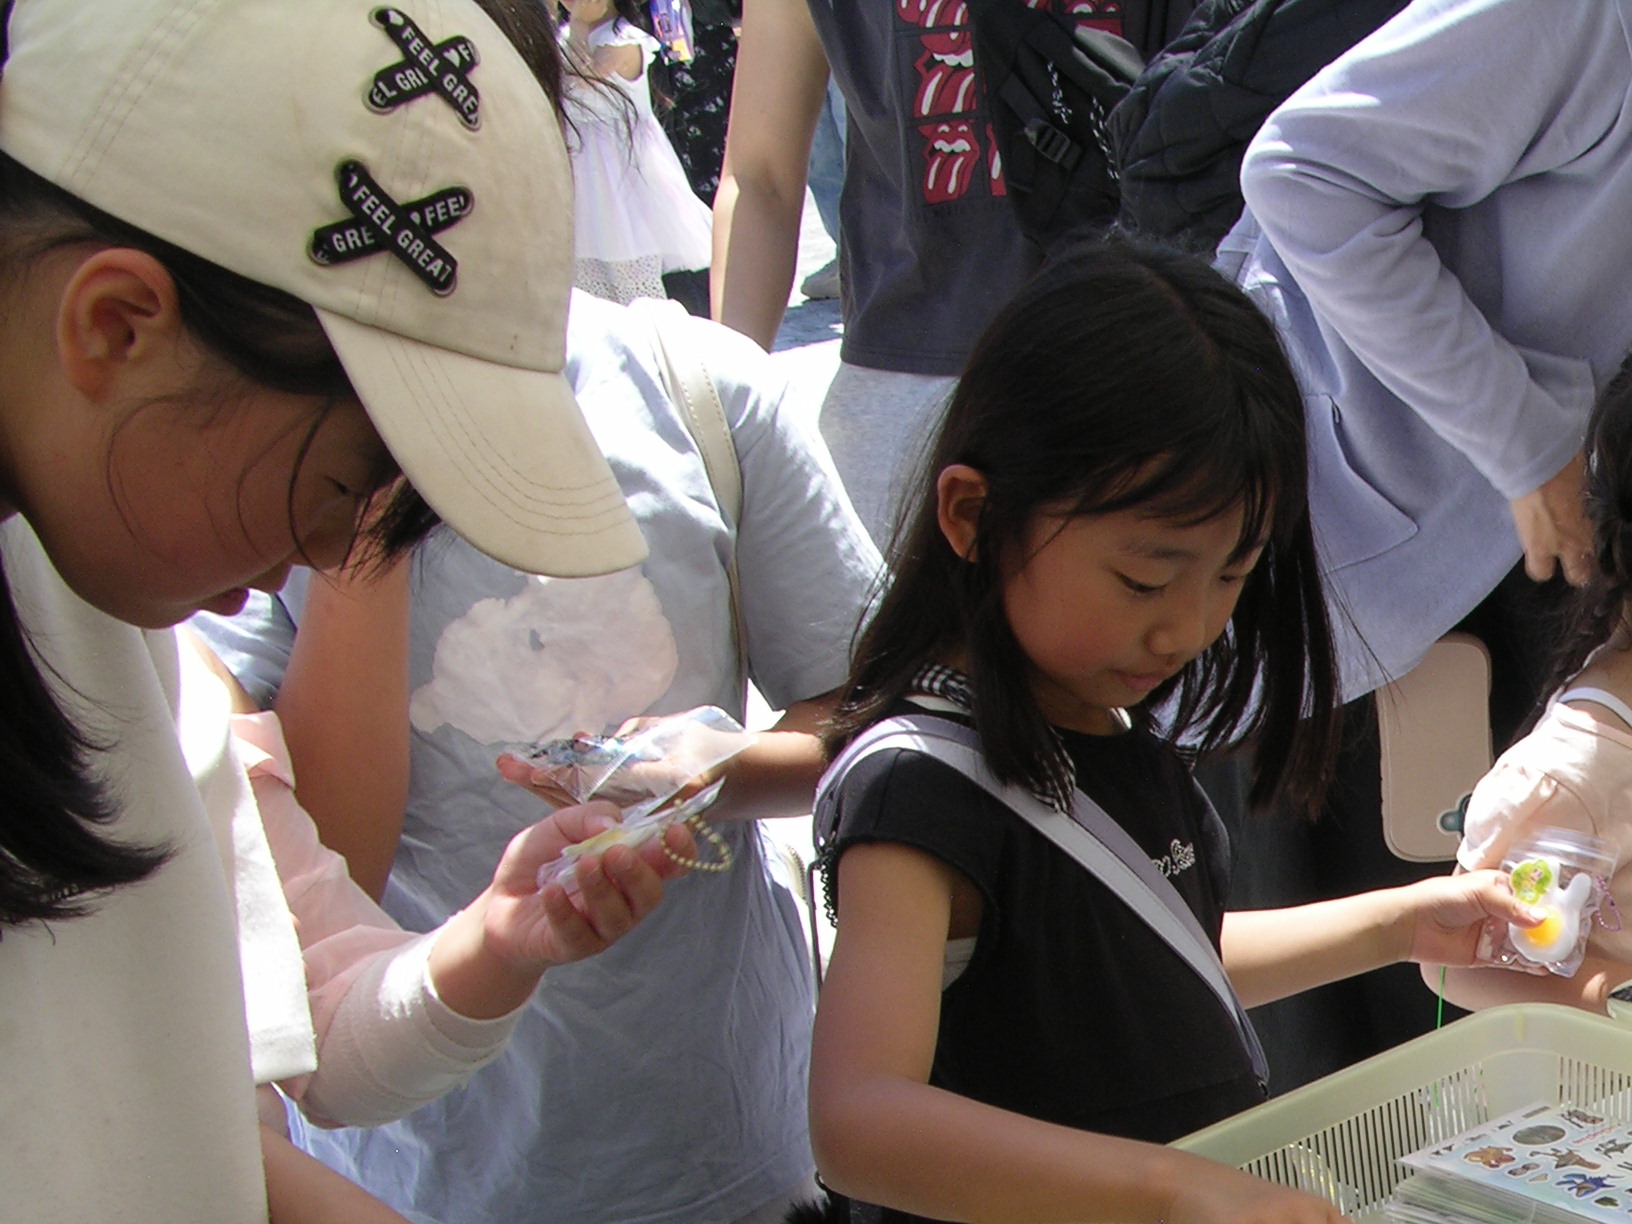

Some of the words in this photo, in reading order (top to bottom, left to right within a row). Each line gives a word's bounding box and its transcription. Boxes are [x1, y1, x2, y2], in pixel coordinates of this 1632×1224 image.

[402, 26, 440, 76] FEEL
[353, 185, 396, 235] FEEL
[397, 229, 452, 283] GREAT
